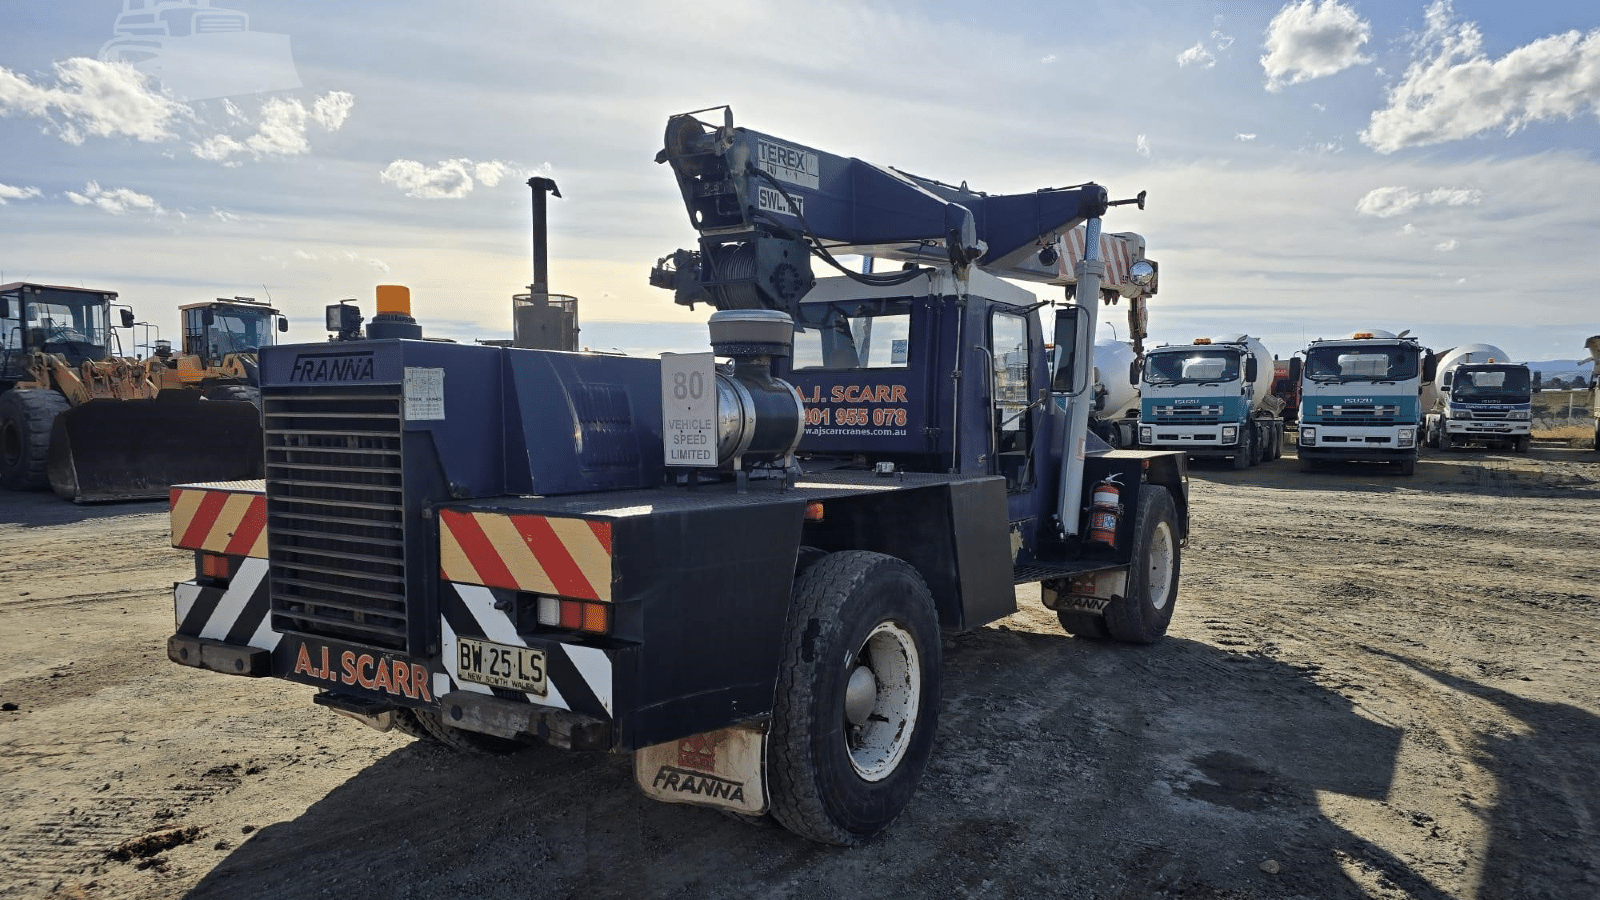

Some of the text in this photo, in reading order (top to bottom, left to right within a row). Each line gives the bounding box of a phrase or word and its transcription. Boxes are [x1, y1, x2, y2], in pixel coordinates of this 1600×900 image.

[758, 141, 805, 171] TEREX
[290, 351, 375, 382] FRANNA
[673, 371, 703, 400] 80
[831, 385, 908, 403] SCARR
[668, 419, 711, 430] VEHICLE
[835, 407, 868, 426] 955
[873, 408, 907, 427] 078
[673, 434, 707, 445] SPEED
[671, 450, 711, 460] LIMITED
[294, 641, 432, 703] A.J. SCARR
[467, 672, 535, 691] NEW SOUTH WALES
[652, 765, 744, 803] FRANNA
